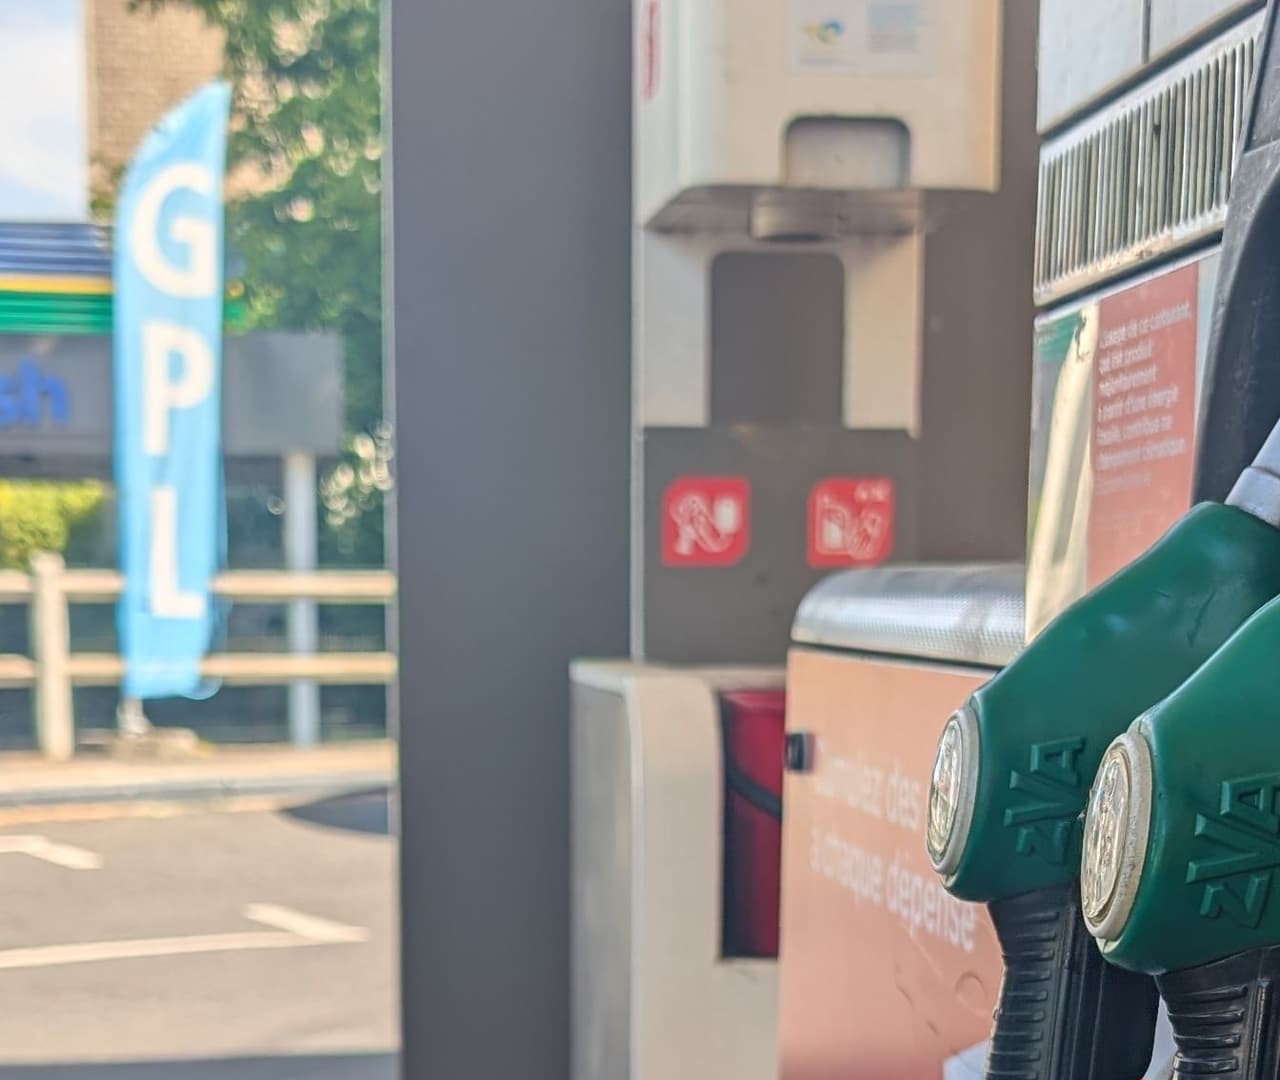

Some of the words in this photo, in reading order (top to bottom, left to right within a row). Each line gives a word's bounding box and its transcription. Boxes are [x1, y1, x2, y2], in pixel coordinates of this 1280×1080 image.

[132, 163, 217, 619] GPL
[1003, 736, 1086, 865] ZVA
[886, 847, 976, 953] dépense
